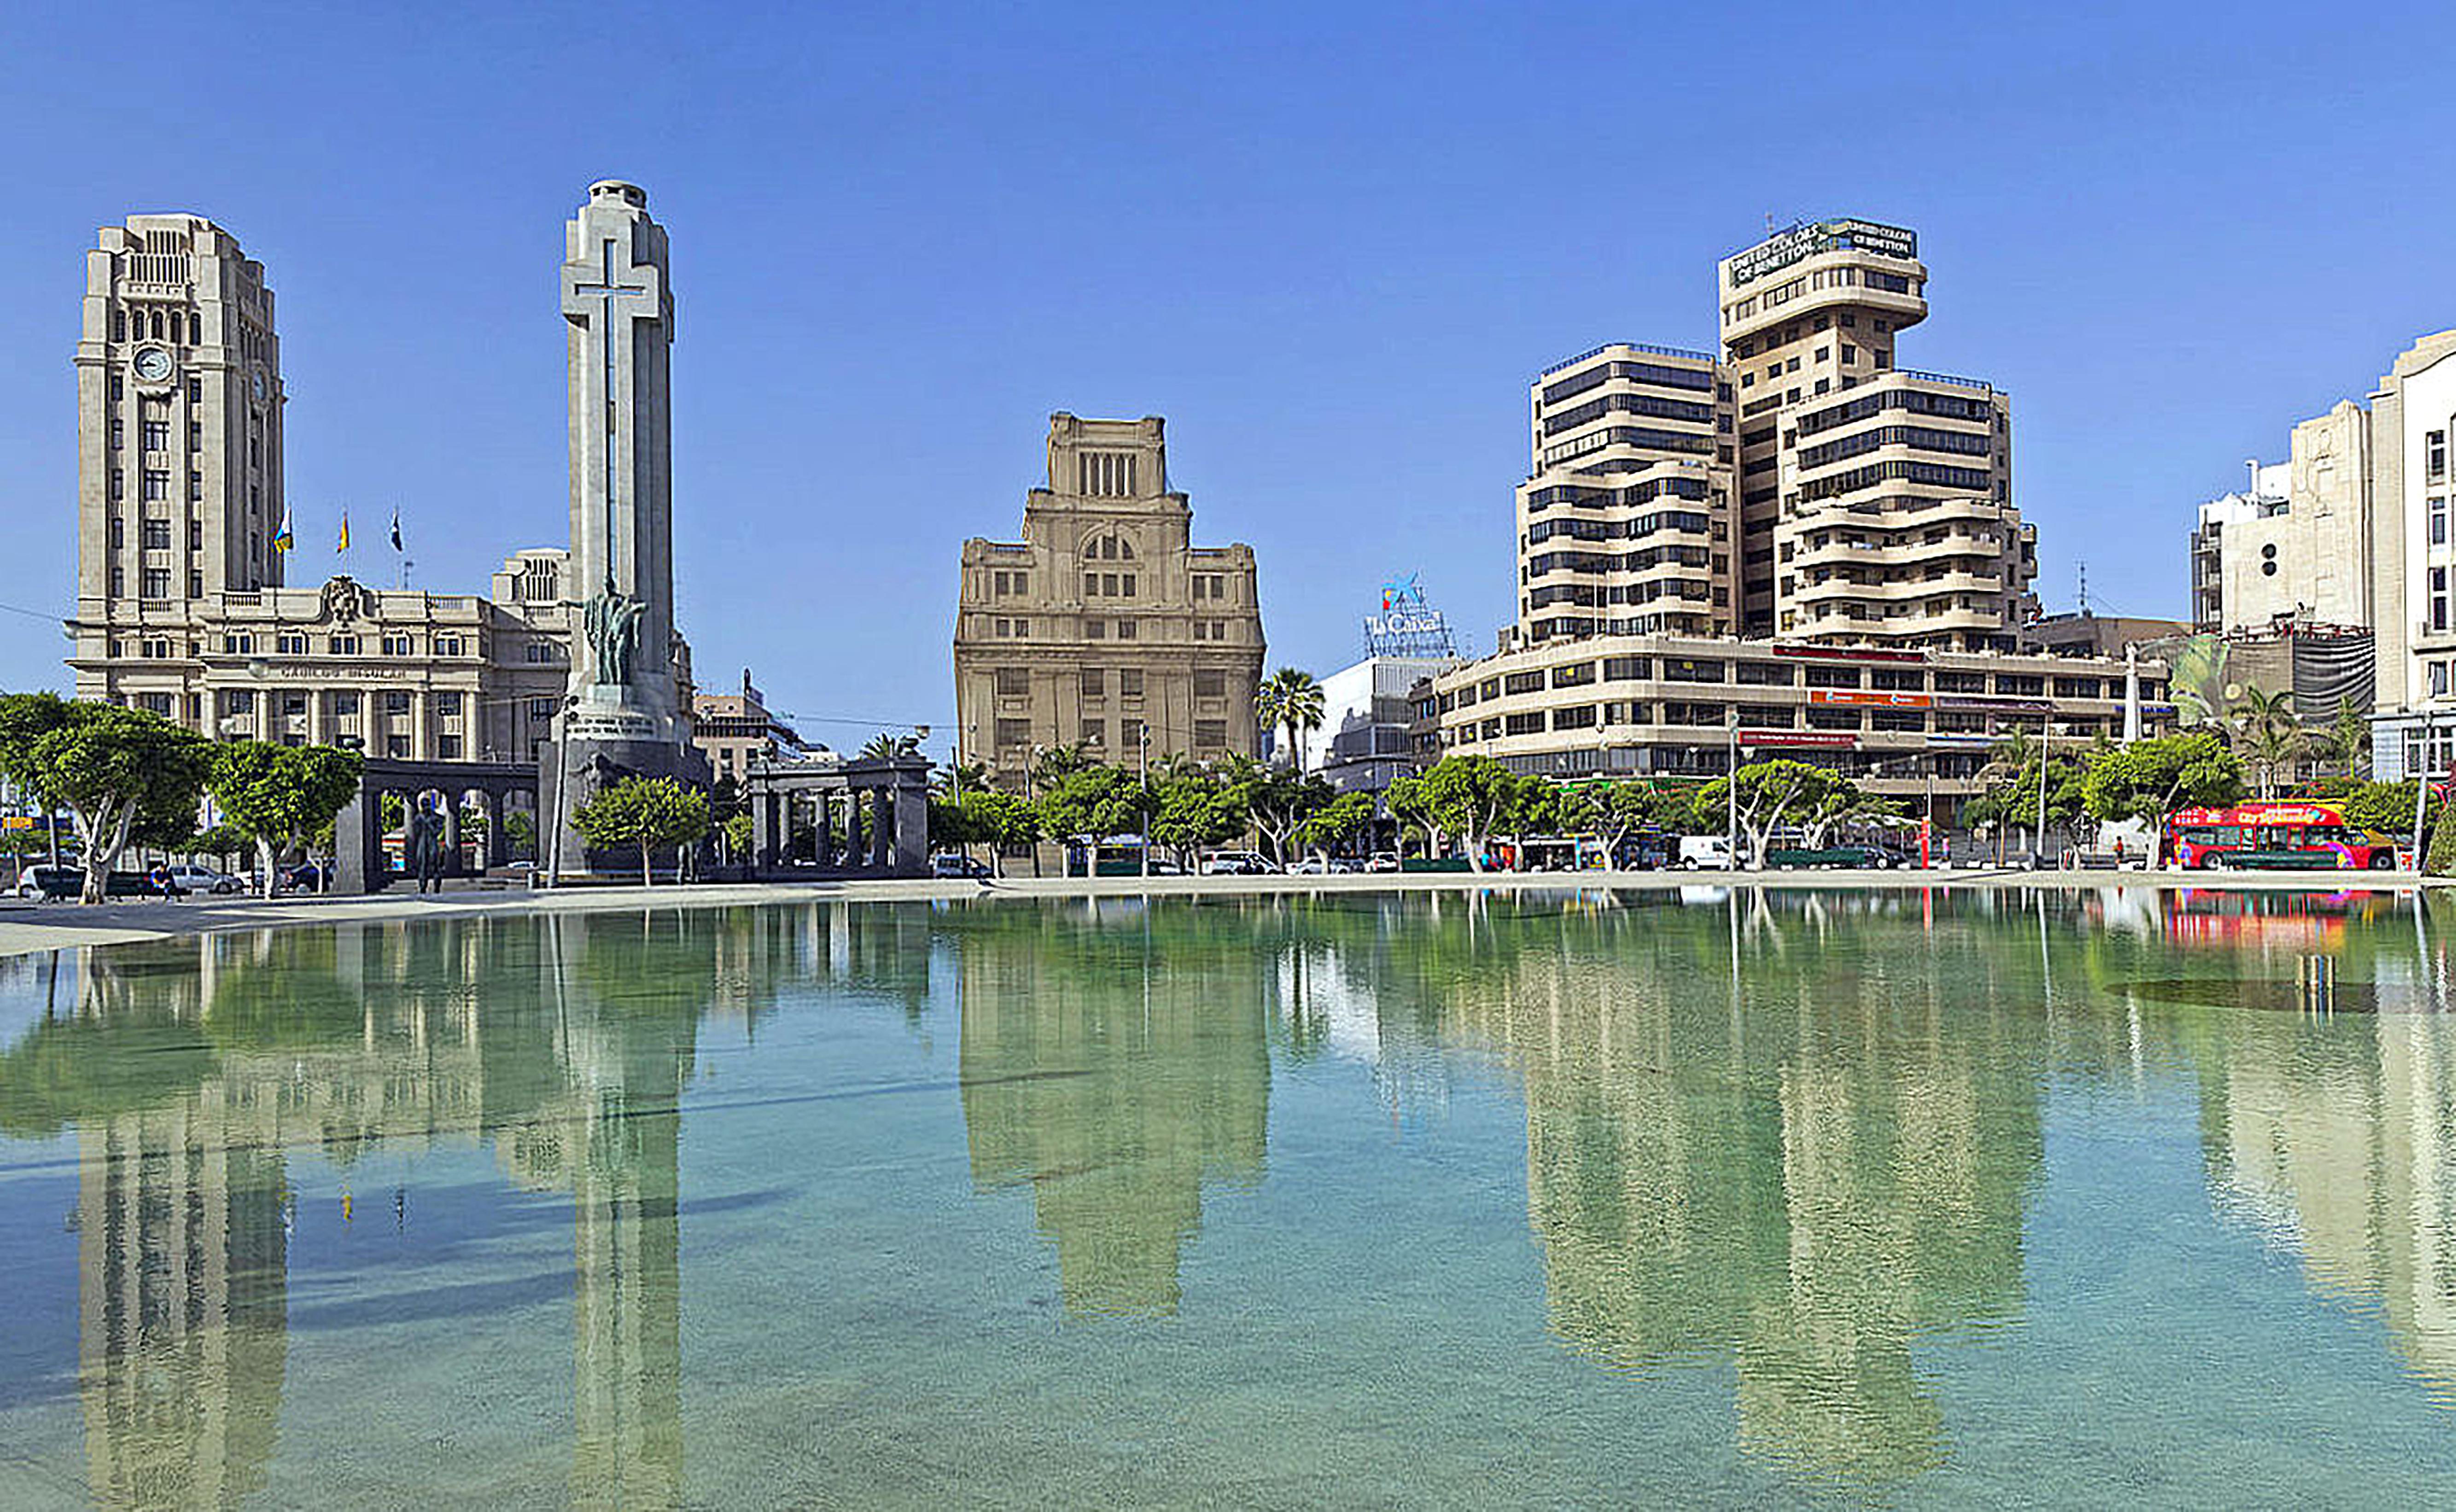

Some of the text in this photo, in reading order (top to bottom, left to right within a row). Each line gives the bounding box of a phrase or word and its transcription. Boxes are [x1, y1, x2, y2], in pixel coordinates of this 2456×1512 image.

[1731, 224, 1818, 271] UNITED COLORS
[1738, 265, 1754, 280] OF
